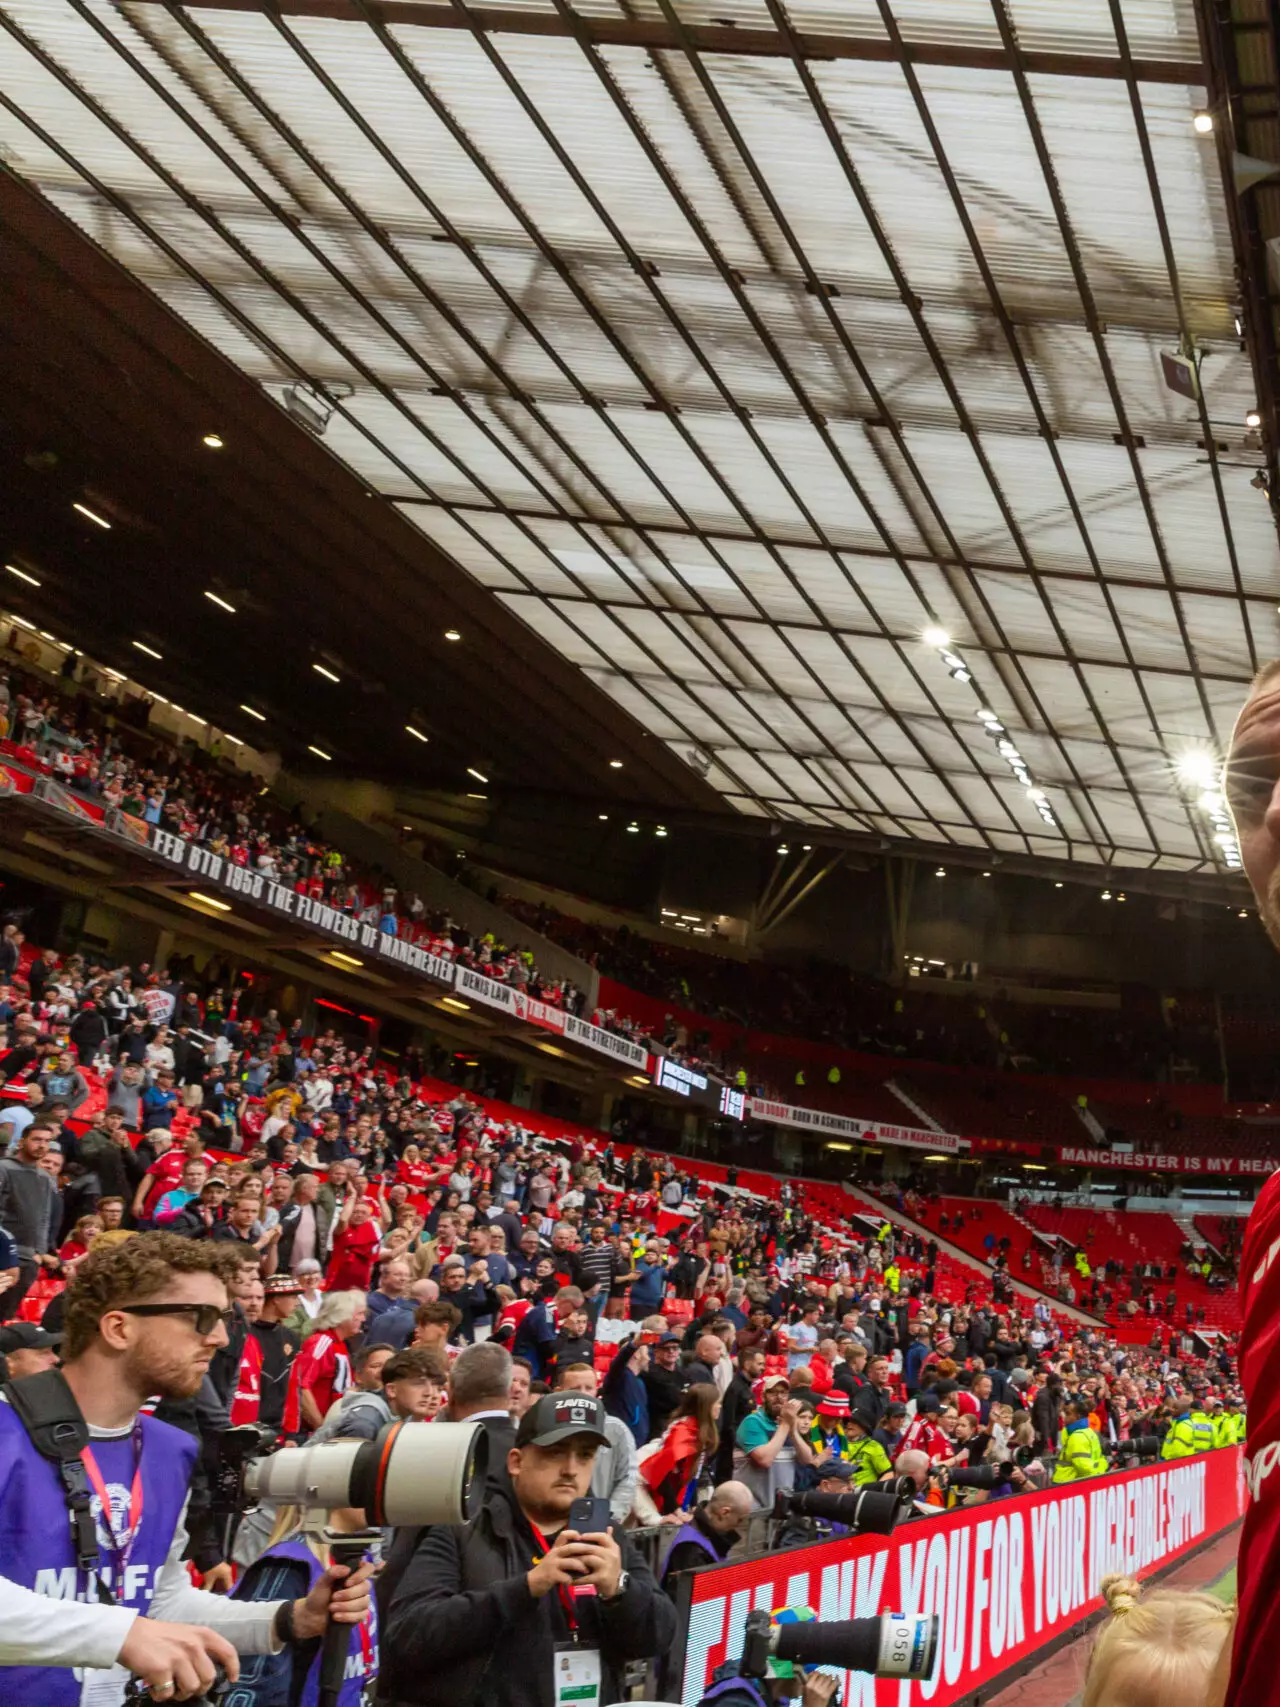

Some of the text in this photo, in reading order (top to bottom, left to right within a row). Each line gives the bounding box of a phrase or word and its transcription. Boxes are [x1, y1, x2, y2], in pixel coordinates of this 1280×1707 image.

[152, 828, 455, 983] FEB 6TH 1958 THE FLOWERS OF MANCHESTER
[462, 970, 489, 996] DENIS
[490, 986, 511, 1004] LAW
[566, 1016, 577, 1033] OF
[578, 1020, 591, 1039] THE
[592, 1024, 630, 1057] STRETFORD
[910, 1130, 957, 1148] MANCHESTER
[1061, 1147, 1179, 1168] MANCHESTER
[1184, 1156, 1201, 1169] IS
[1207, 1158, 1233, 1172] MY
[899, 1526, 970, 1707] YOU
[970, 1512, 1025, 1672] FOR
[1031, 1494, 1086, 1633] YOUR
[1088, 1473, 1167, 1600] INCREDIBLE
[1167, 1461, 1206, 1553] SUPPORT
[892, 1627, 910, 1662] 058
